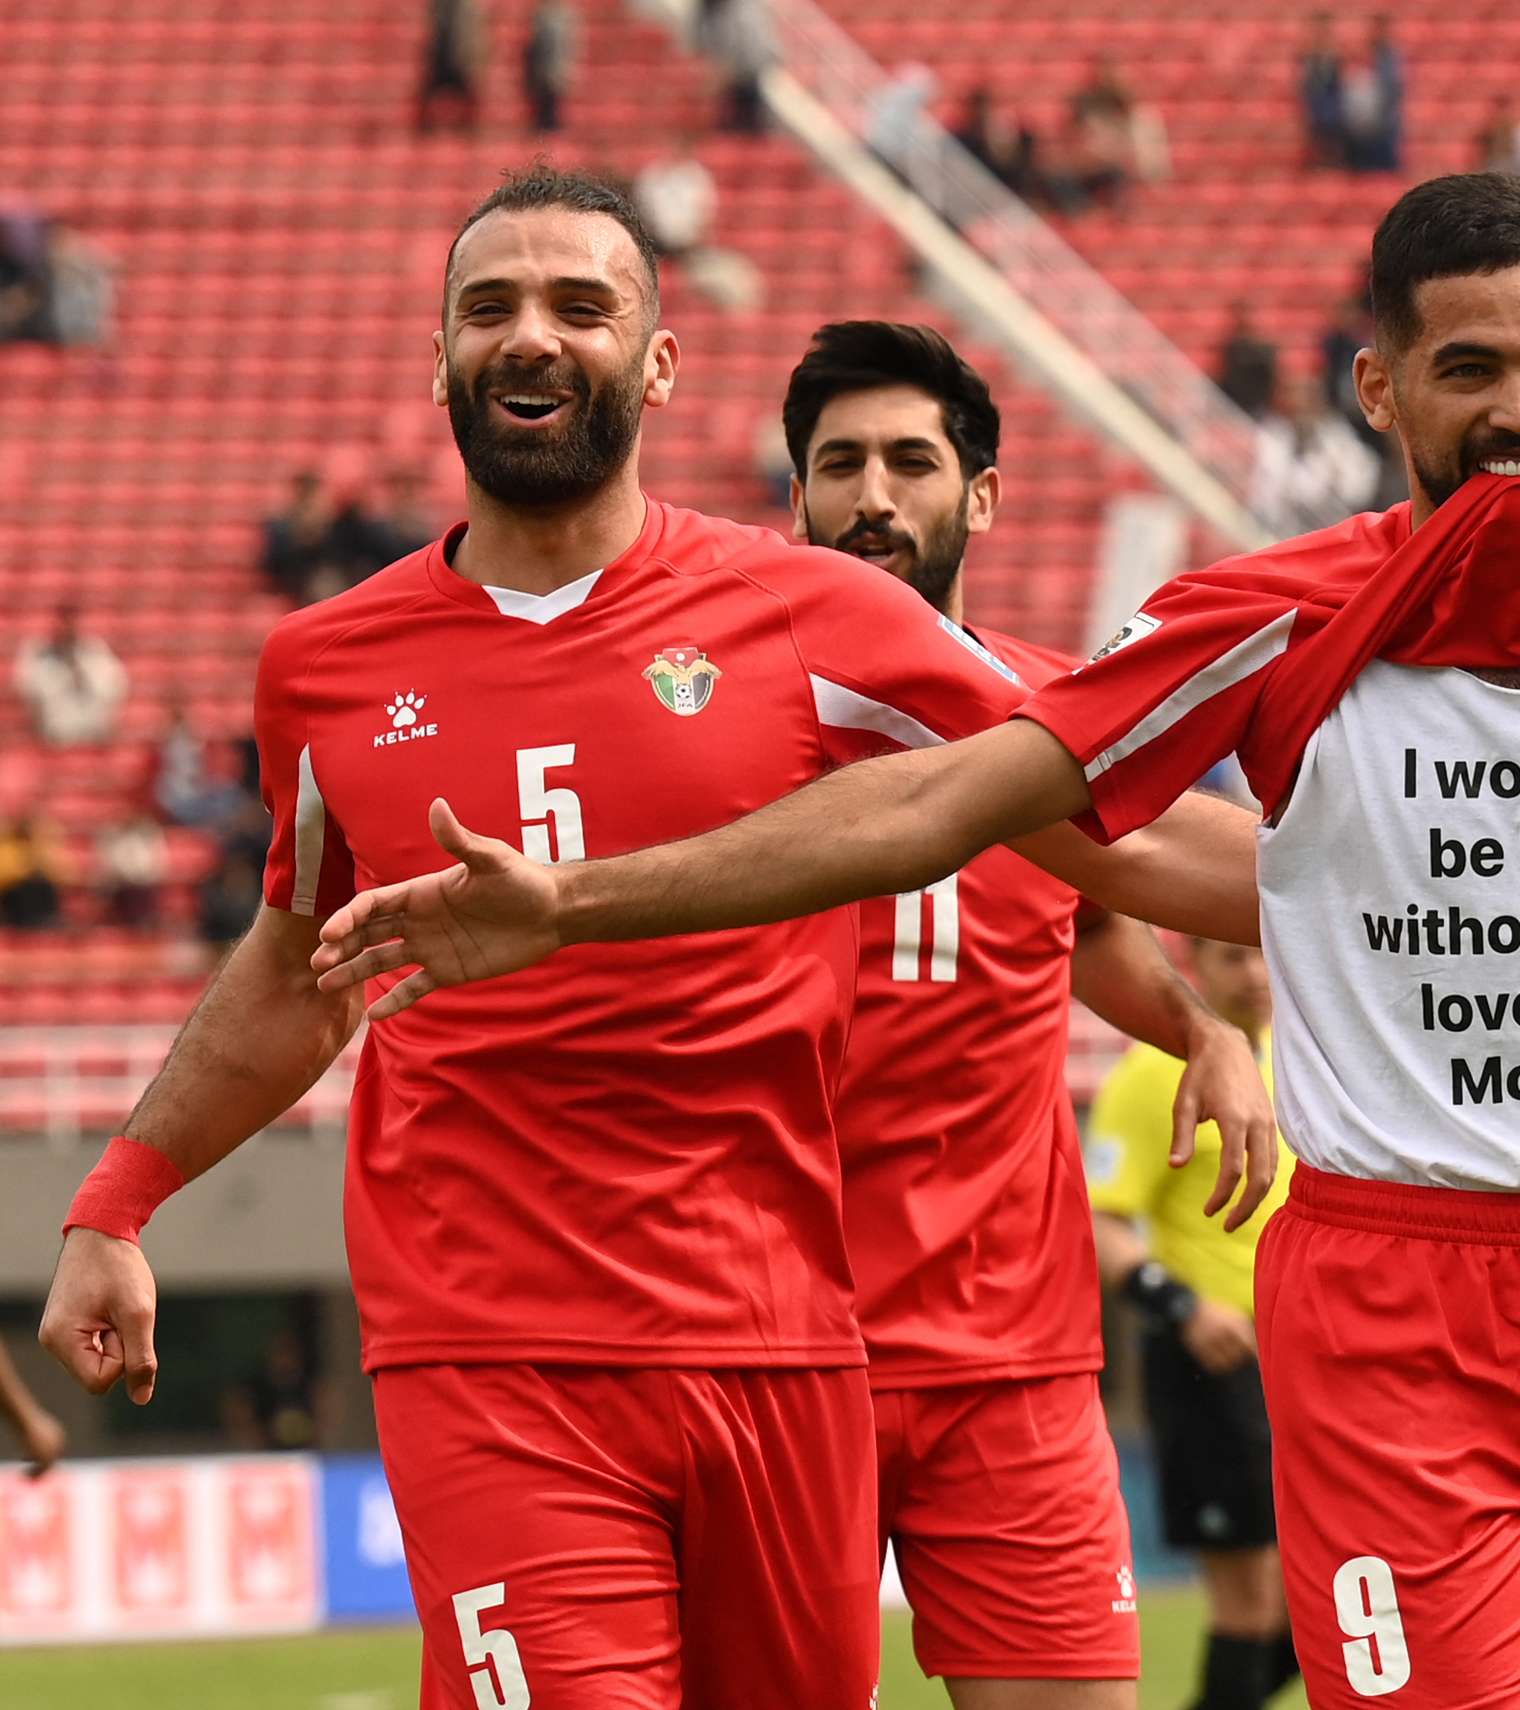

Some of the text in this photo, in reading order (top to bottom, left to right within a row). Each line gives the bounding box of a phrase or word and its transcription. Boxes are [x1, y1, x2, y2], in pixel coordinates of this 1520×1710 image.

[373, 723, 439, 749] KELME
[1404, 748, 1417, 799] I
[516, 743, 586, 867] 5
[1429, 827, 1504, 879] be
[892, 872, 960, 982] 11
[452, 1581, 531, 1710] 5
[1333, 1556, 1411, 1697] 9
